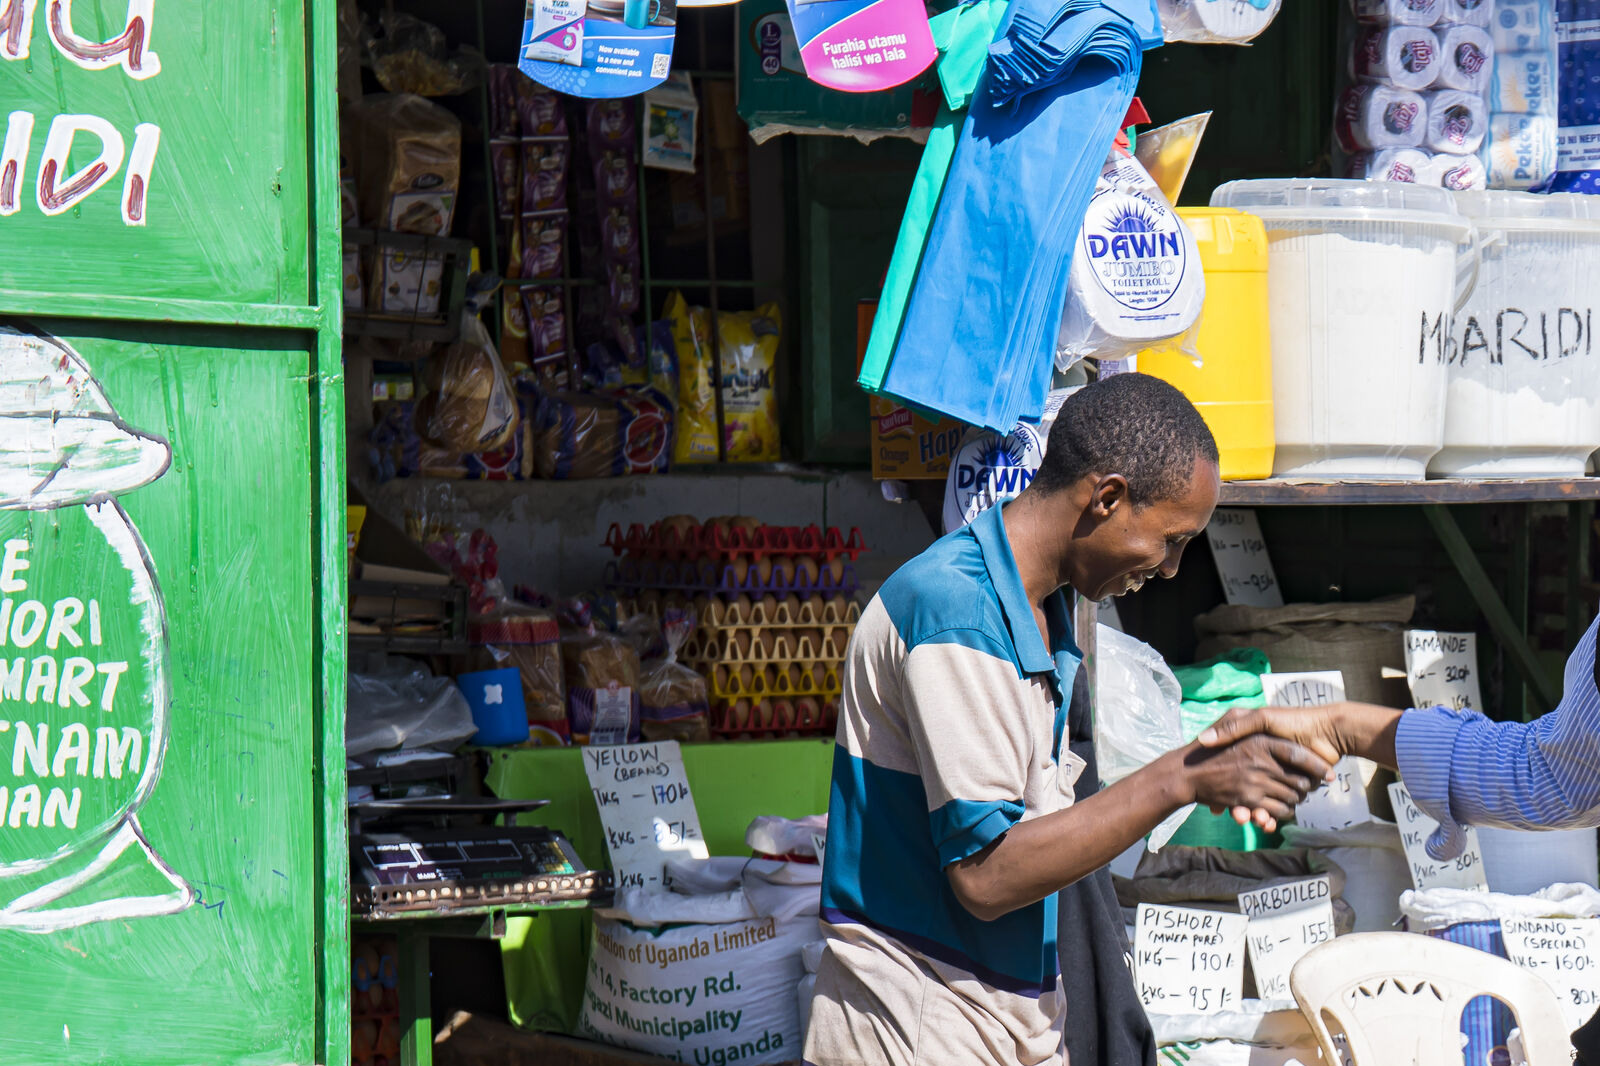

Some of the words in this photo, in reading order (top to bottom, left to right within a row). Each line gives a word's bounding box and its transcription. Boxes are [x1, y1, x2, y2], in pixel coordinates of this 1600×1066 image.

[822, 37, 867, 56] Furahia
[869, 33, 907, 49] utamu
[831, 52, 862, 70] halisi
[864, 53, 882, 65] wa
[883, 47, 907, 62] lala
[1088, 231, 1180, 261] DAWN
[1103, 260, 1176, 278] JUMBO
[1112, 278, 1144, 287] TOILET
[1147, 278, 1171, 286] ROLL
[959, 464, 1038, 493] DAWN
[1408, 636, 1468, 653] KAMANDE
[0, 721, 142, 780] NAM
[614, 762, 670, 783] (BEANS)
[1403, 831, 1423, 850] 1KG
[1242, 880, 1329, 917] PARBOILED
[1144, 908, 1223, 935] PISHORI
[1504, 919, 1567, 935] SINDANO
[628, 945, 643, 963] of
[646, 937, 710, 969] Uganda
[713, 914, 776, 954] Limited
[1193, 933, 1224, 947] PURE)
[1523, 936, 1586, 950] (SPECIAL)
[620, 979, 697, 1007] Factory
[704, 970, 742, 998] Rd.
[615, 1009, 742, 1041] Municipality
